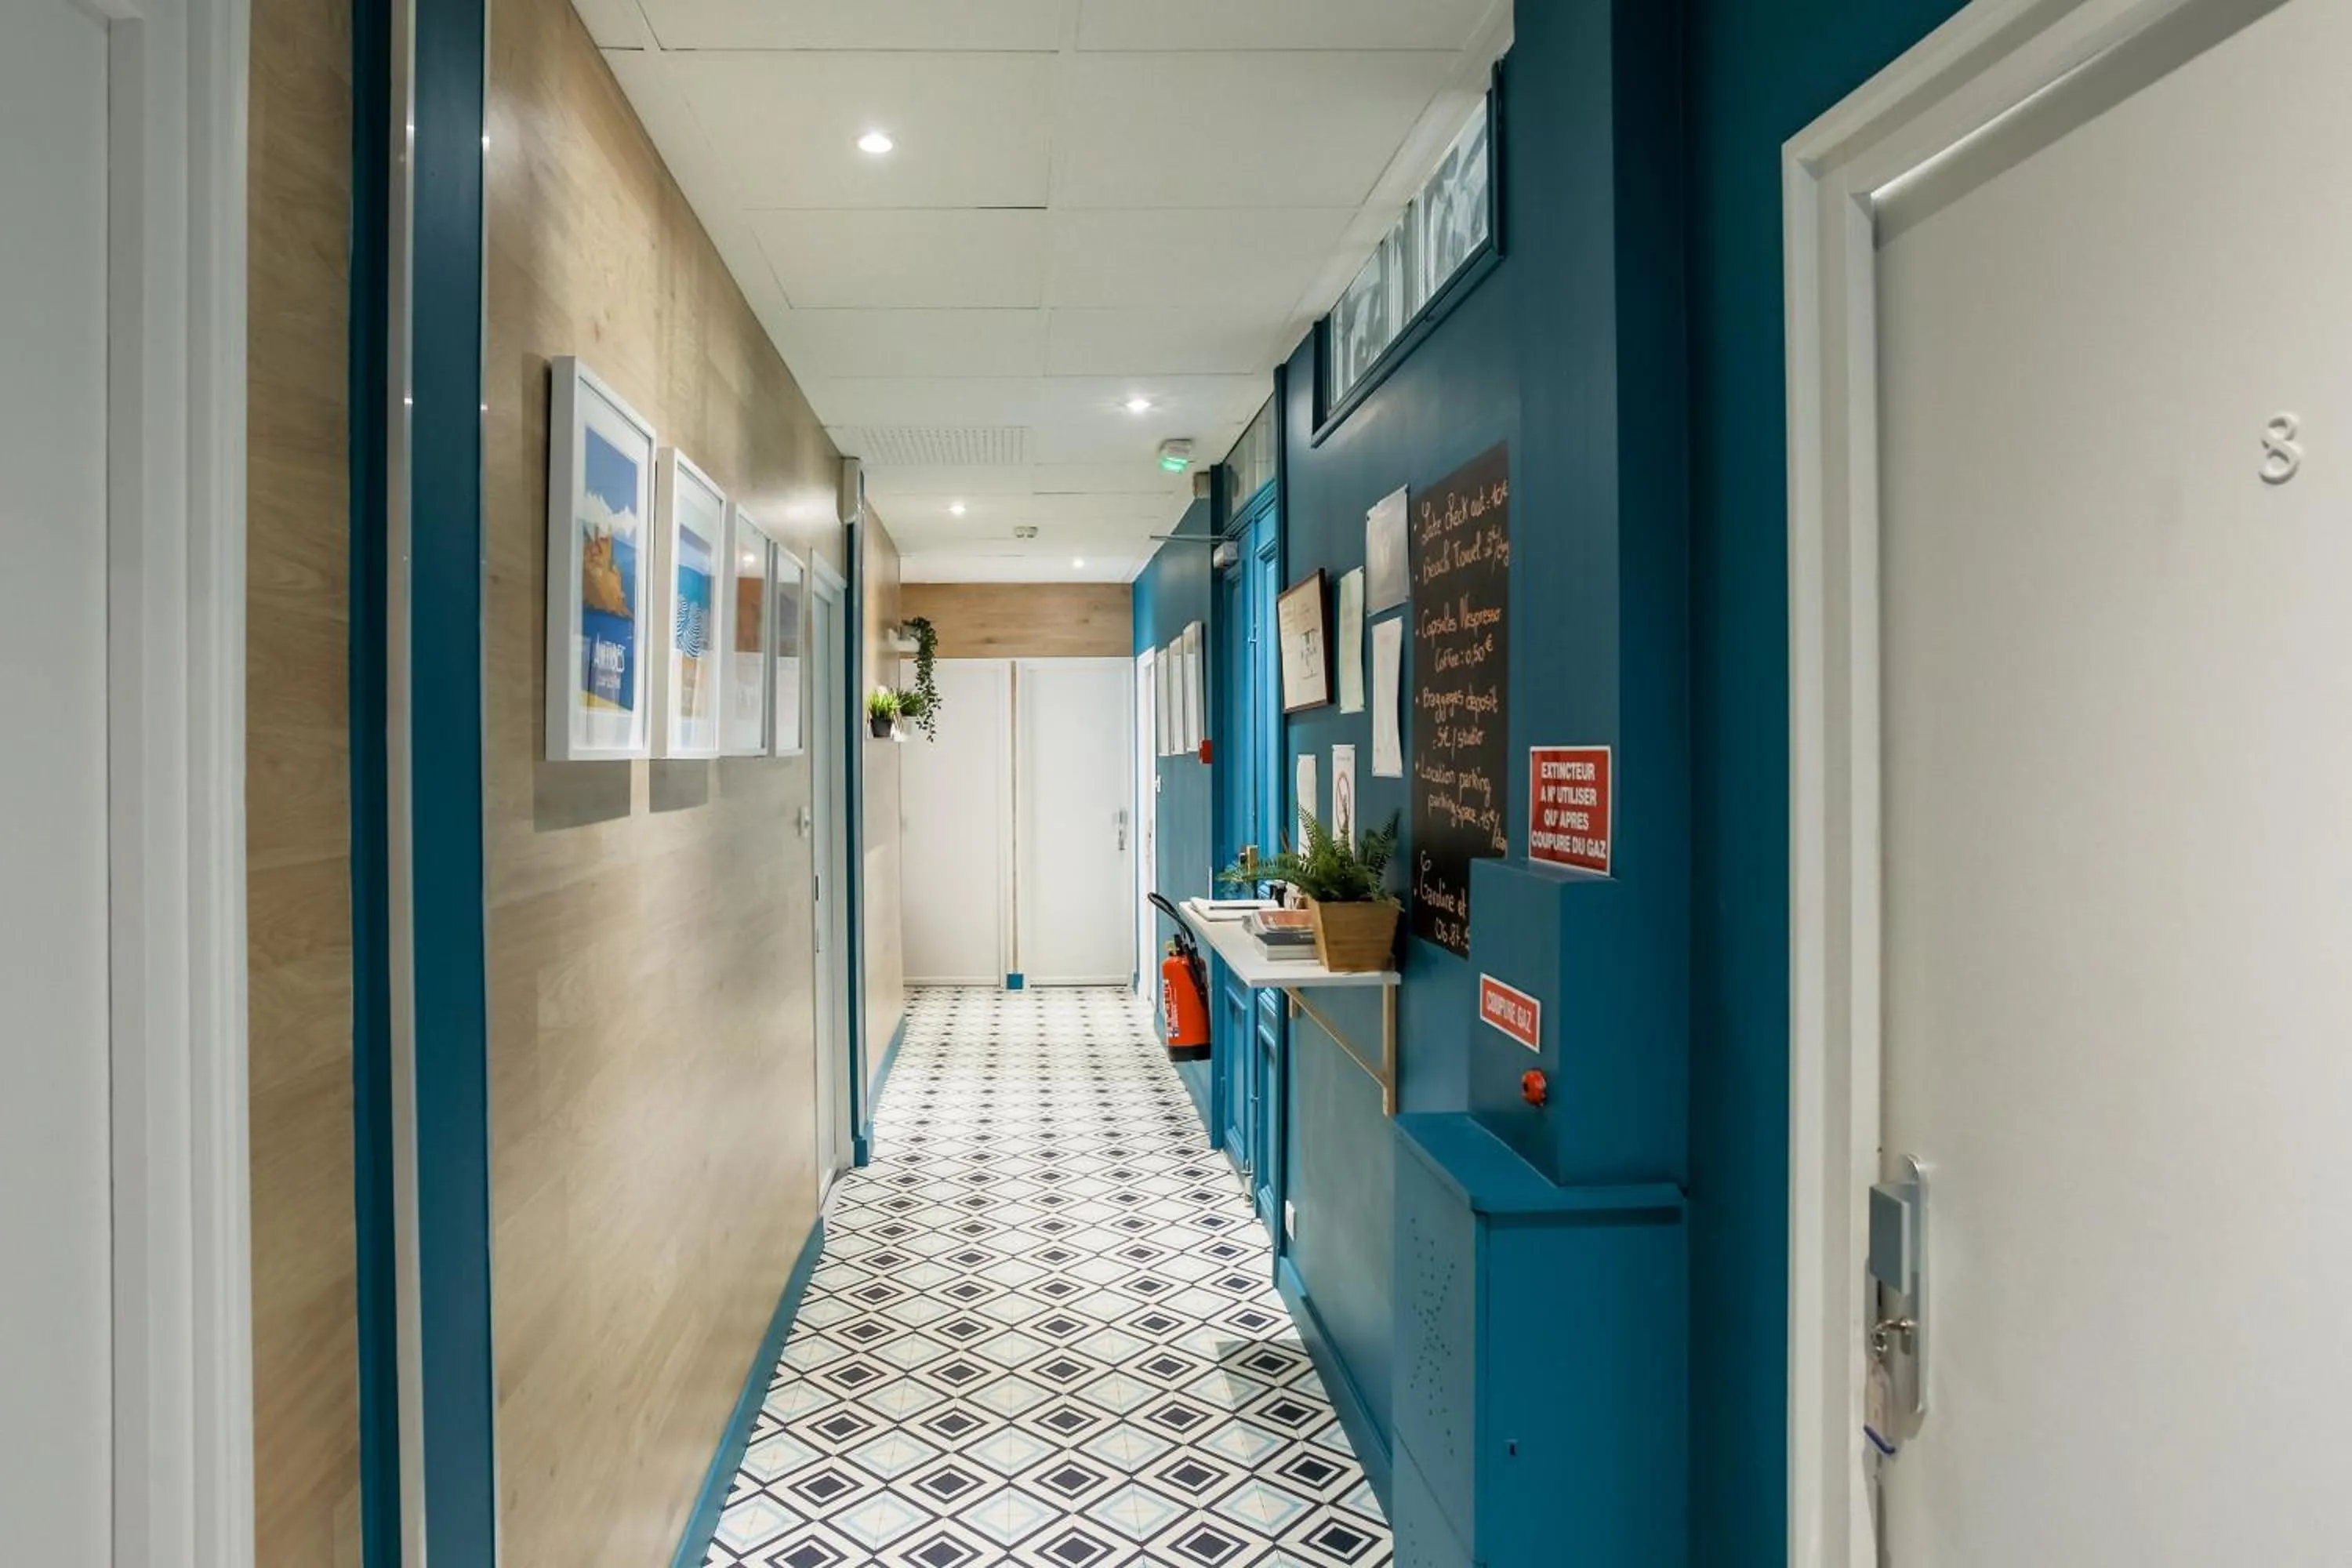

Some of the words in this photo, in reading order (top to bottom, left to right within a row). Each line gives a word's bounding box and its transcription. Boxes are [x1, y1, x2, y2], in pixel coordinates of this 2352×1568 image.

[2258, 412, 2303, 486] 8
[1541, 761, 1595, 781] EXTINCTEUR
[1531, 830, 1570, 851] COUPURE
[1572, 835, 1585, 855] DU
[1587, 837, 1606, 859] GAZ
